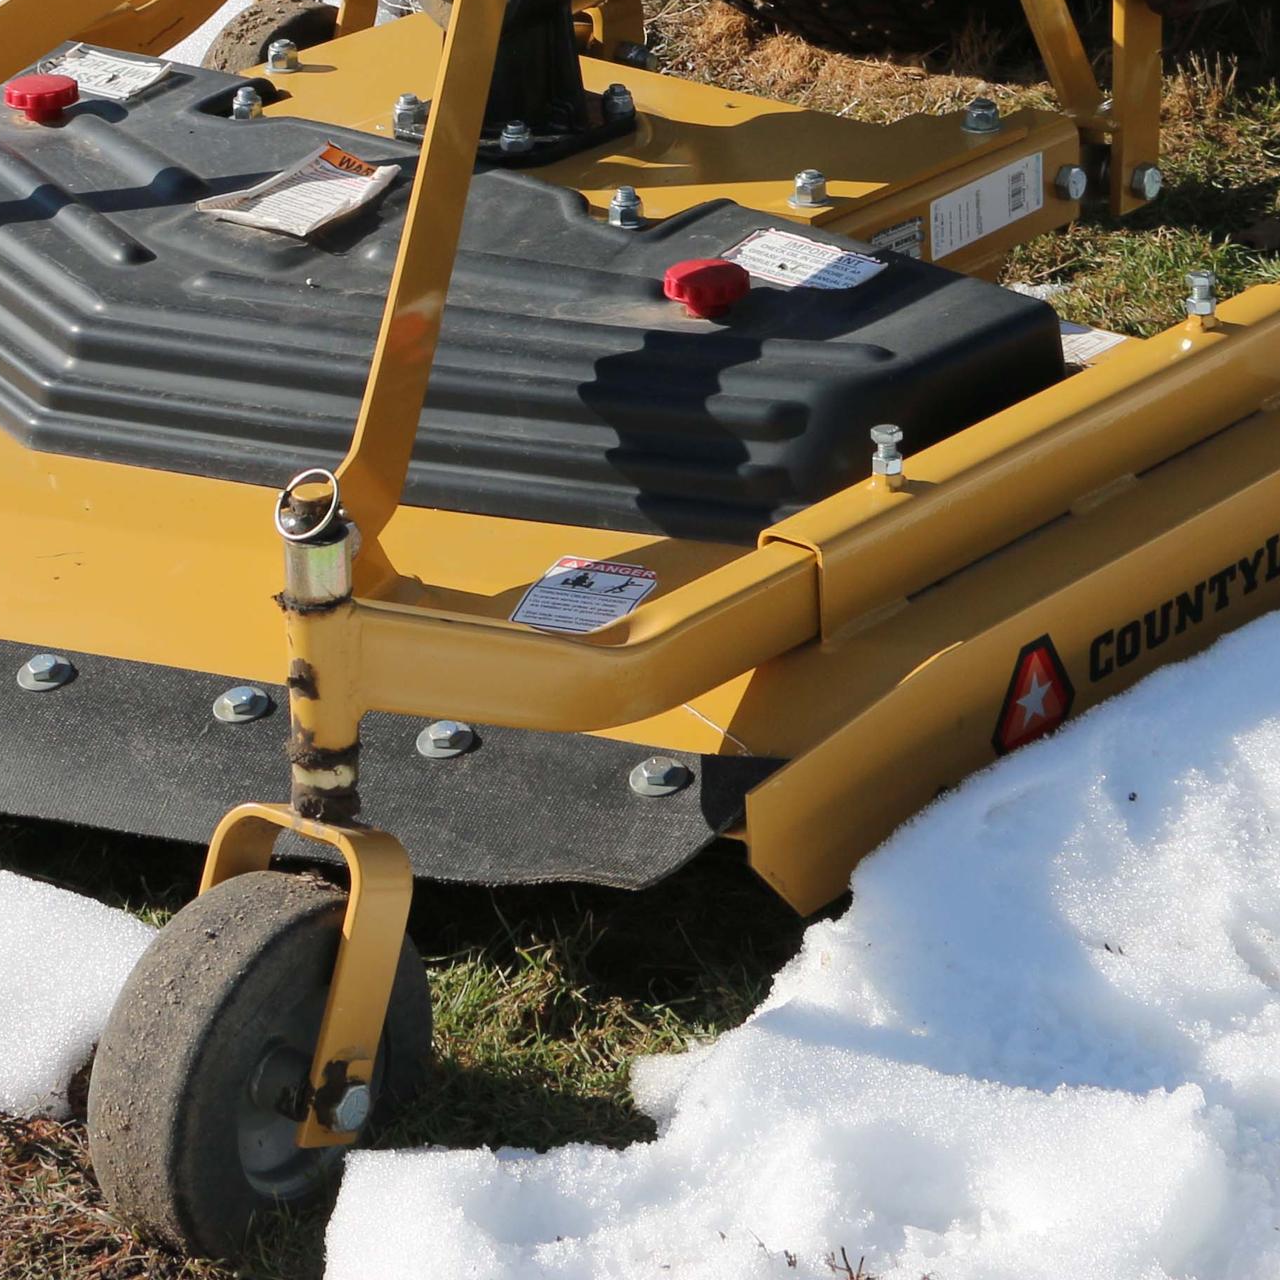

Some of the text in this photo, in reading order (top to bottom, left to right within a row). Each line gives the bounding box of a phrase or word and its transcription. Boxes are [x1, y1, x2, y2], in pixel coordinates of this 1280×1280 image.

[339, 155, 375, 177] WAR
[785, 240, 865, 267] IMPORTANT
[585, 561, 657, 579] DANGER
